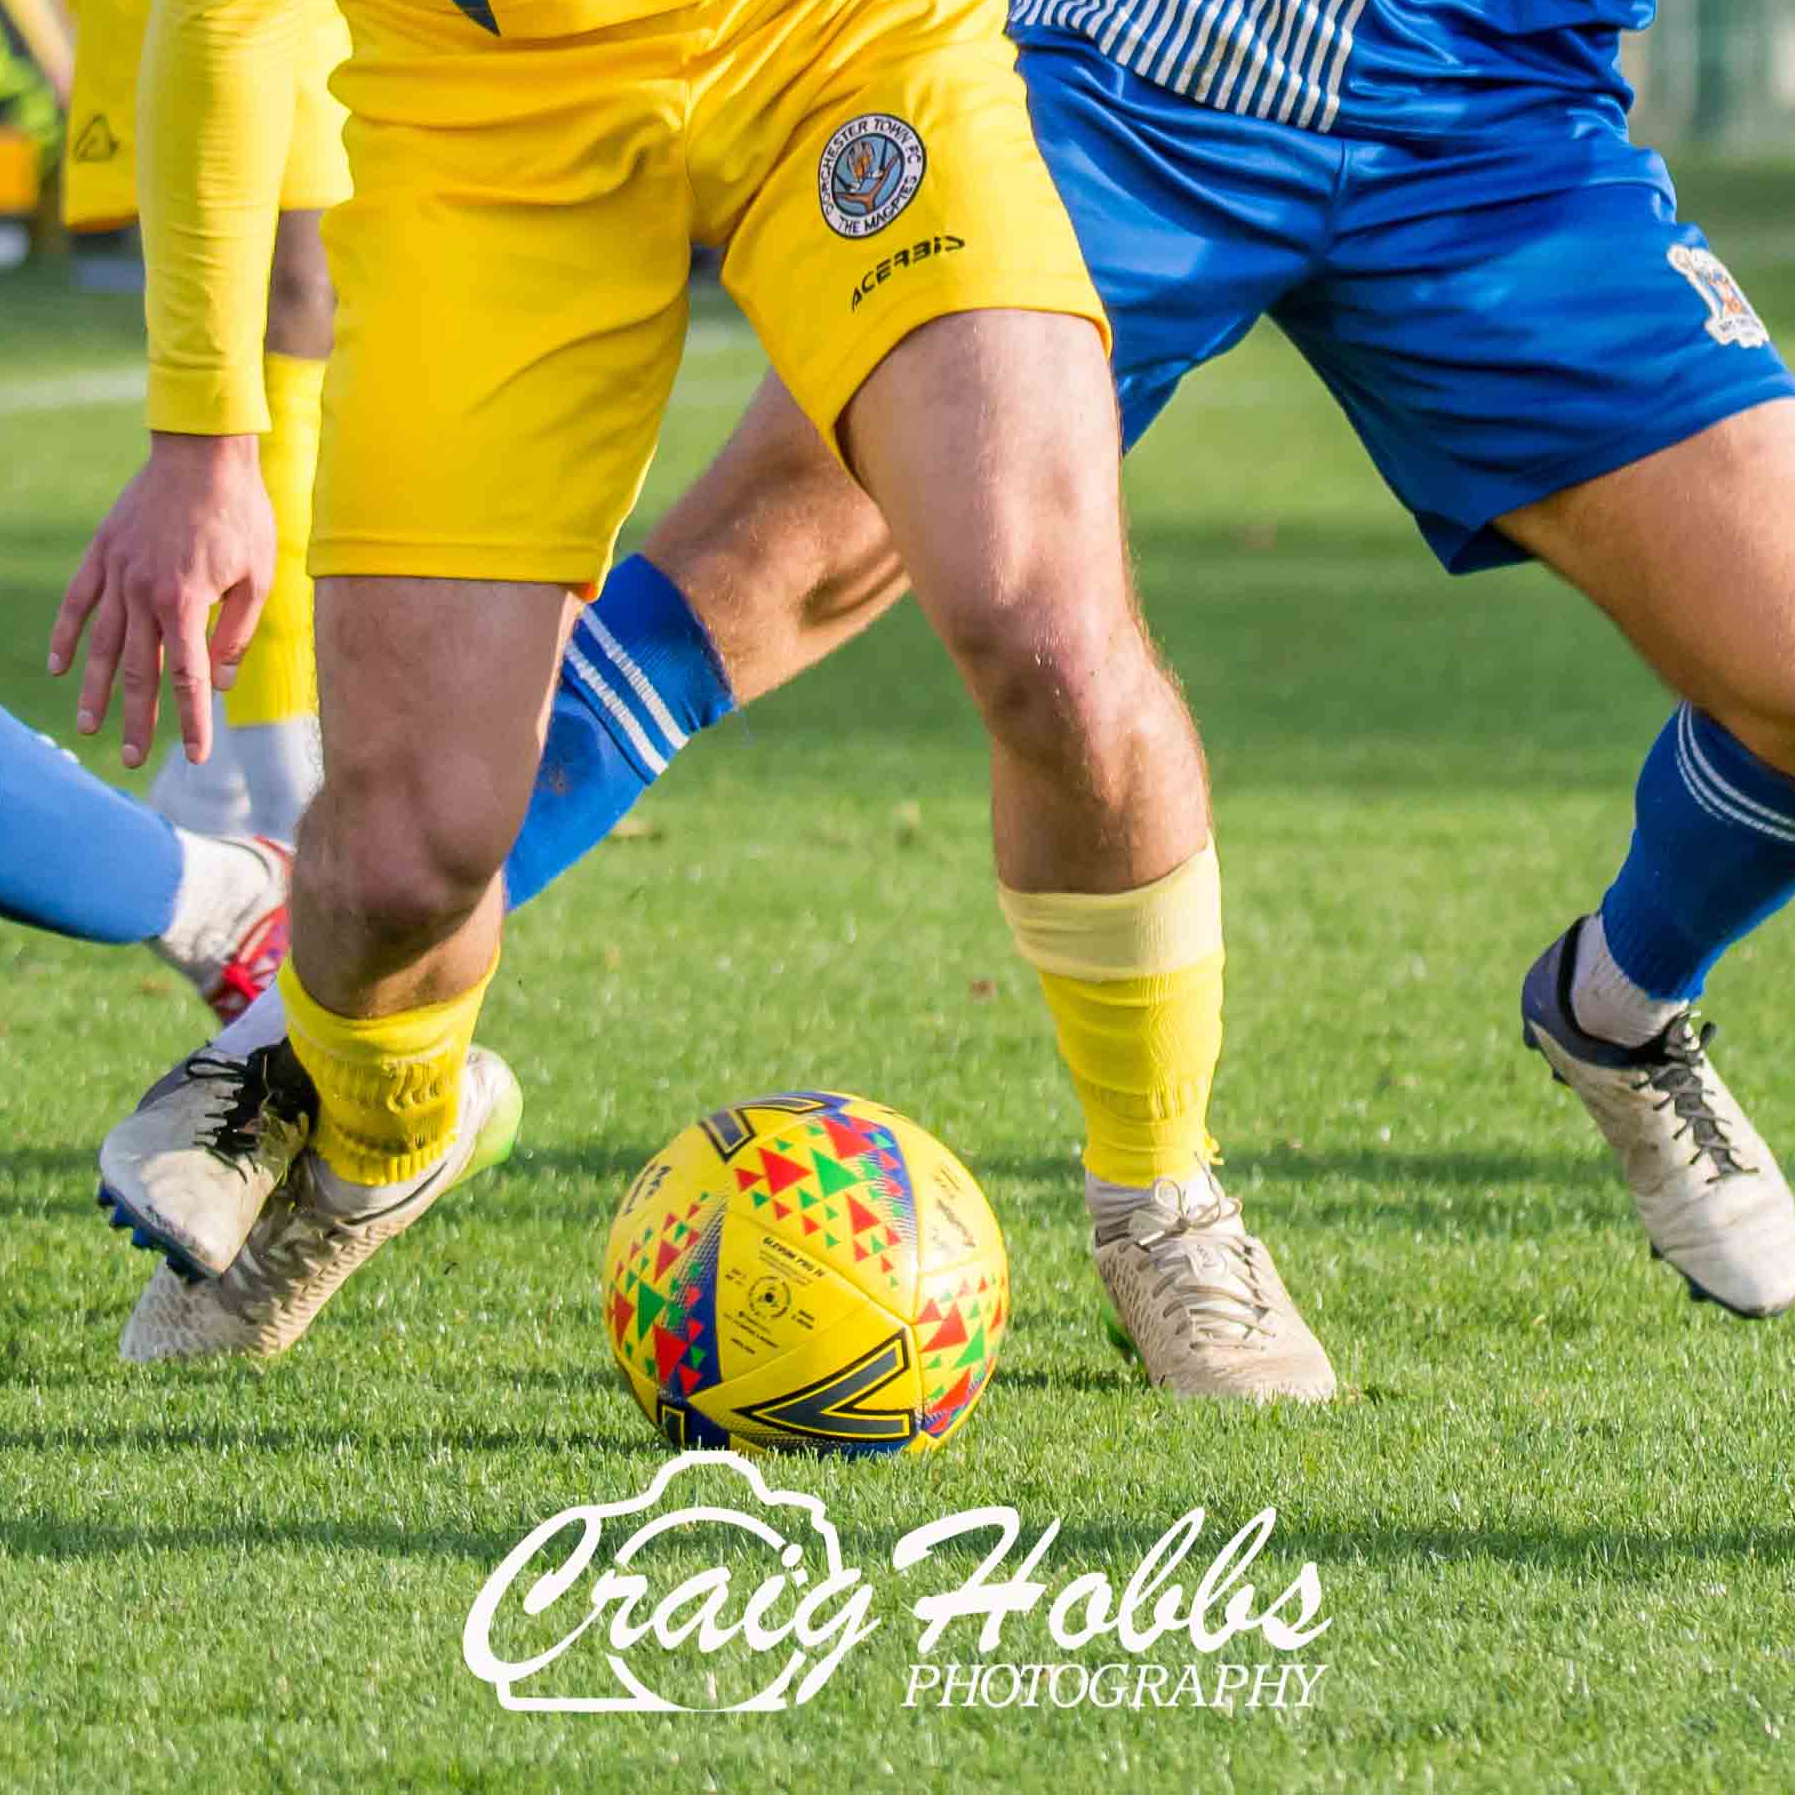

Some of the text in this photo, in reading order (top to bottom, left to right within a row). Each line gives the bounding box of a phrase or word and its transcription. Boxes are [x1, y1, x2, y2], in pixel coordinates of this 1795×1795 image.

[820, 117, 922, 216] DORCHESTER TOWN FC
[838, 175, 918, 234] THE MAGPIES
[851, 234, 966, 313] ACERBIS
